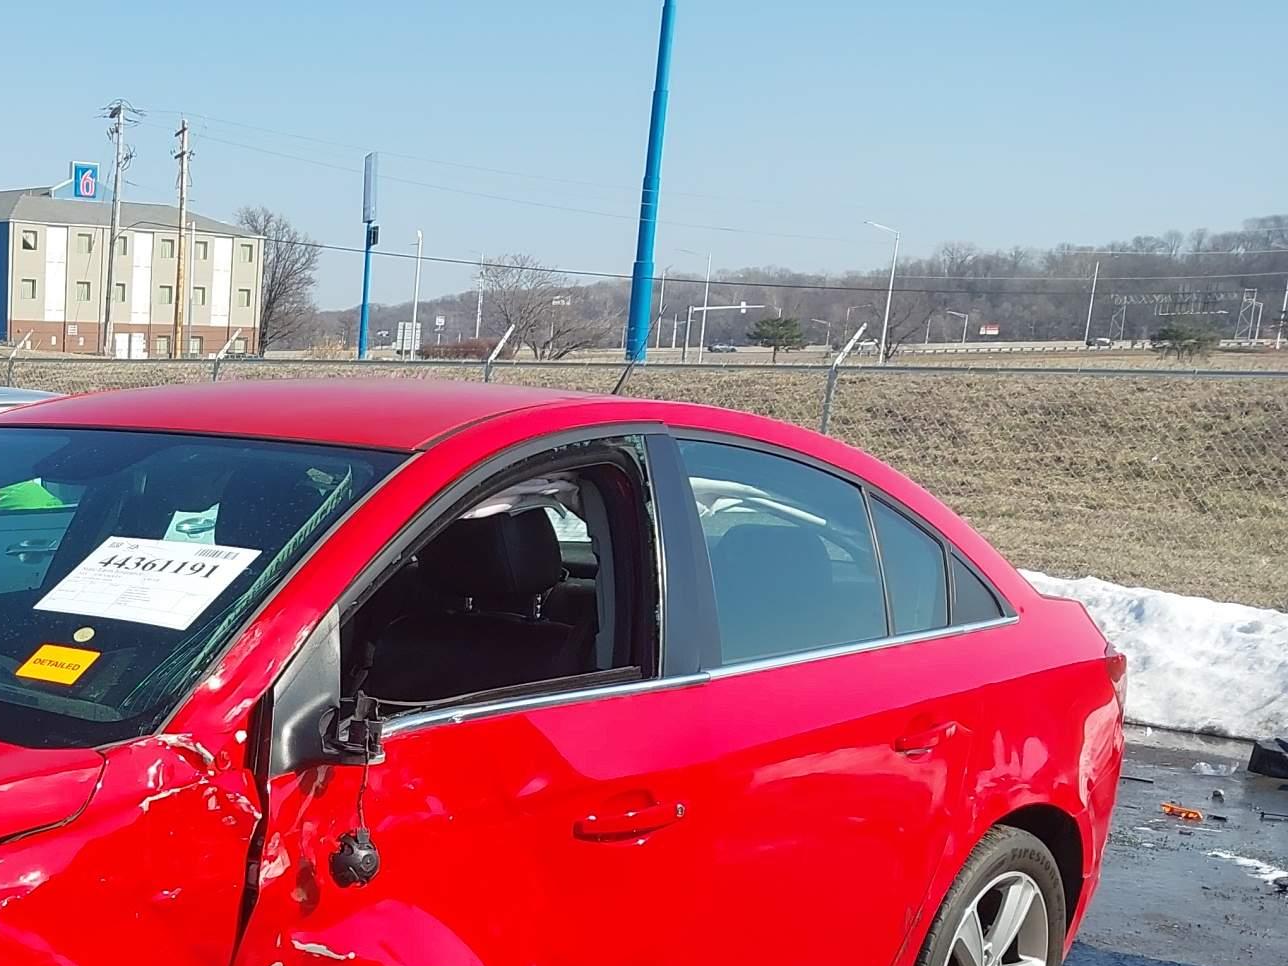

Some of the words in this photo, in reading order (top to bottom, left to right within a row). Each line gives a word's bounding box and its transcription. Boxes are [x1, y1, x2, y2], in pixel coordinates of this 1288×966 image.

[80, 169, 95, 197] 6
[98, 554, 220, 579] 44361191
[33, 657, 81, 671] DETAILED
